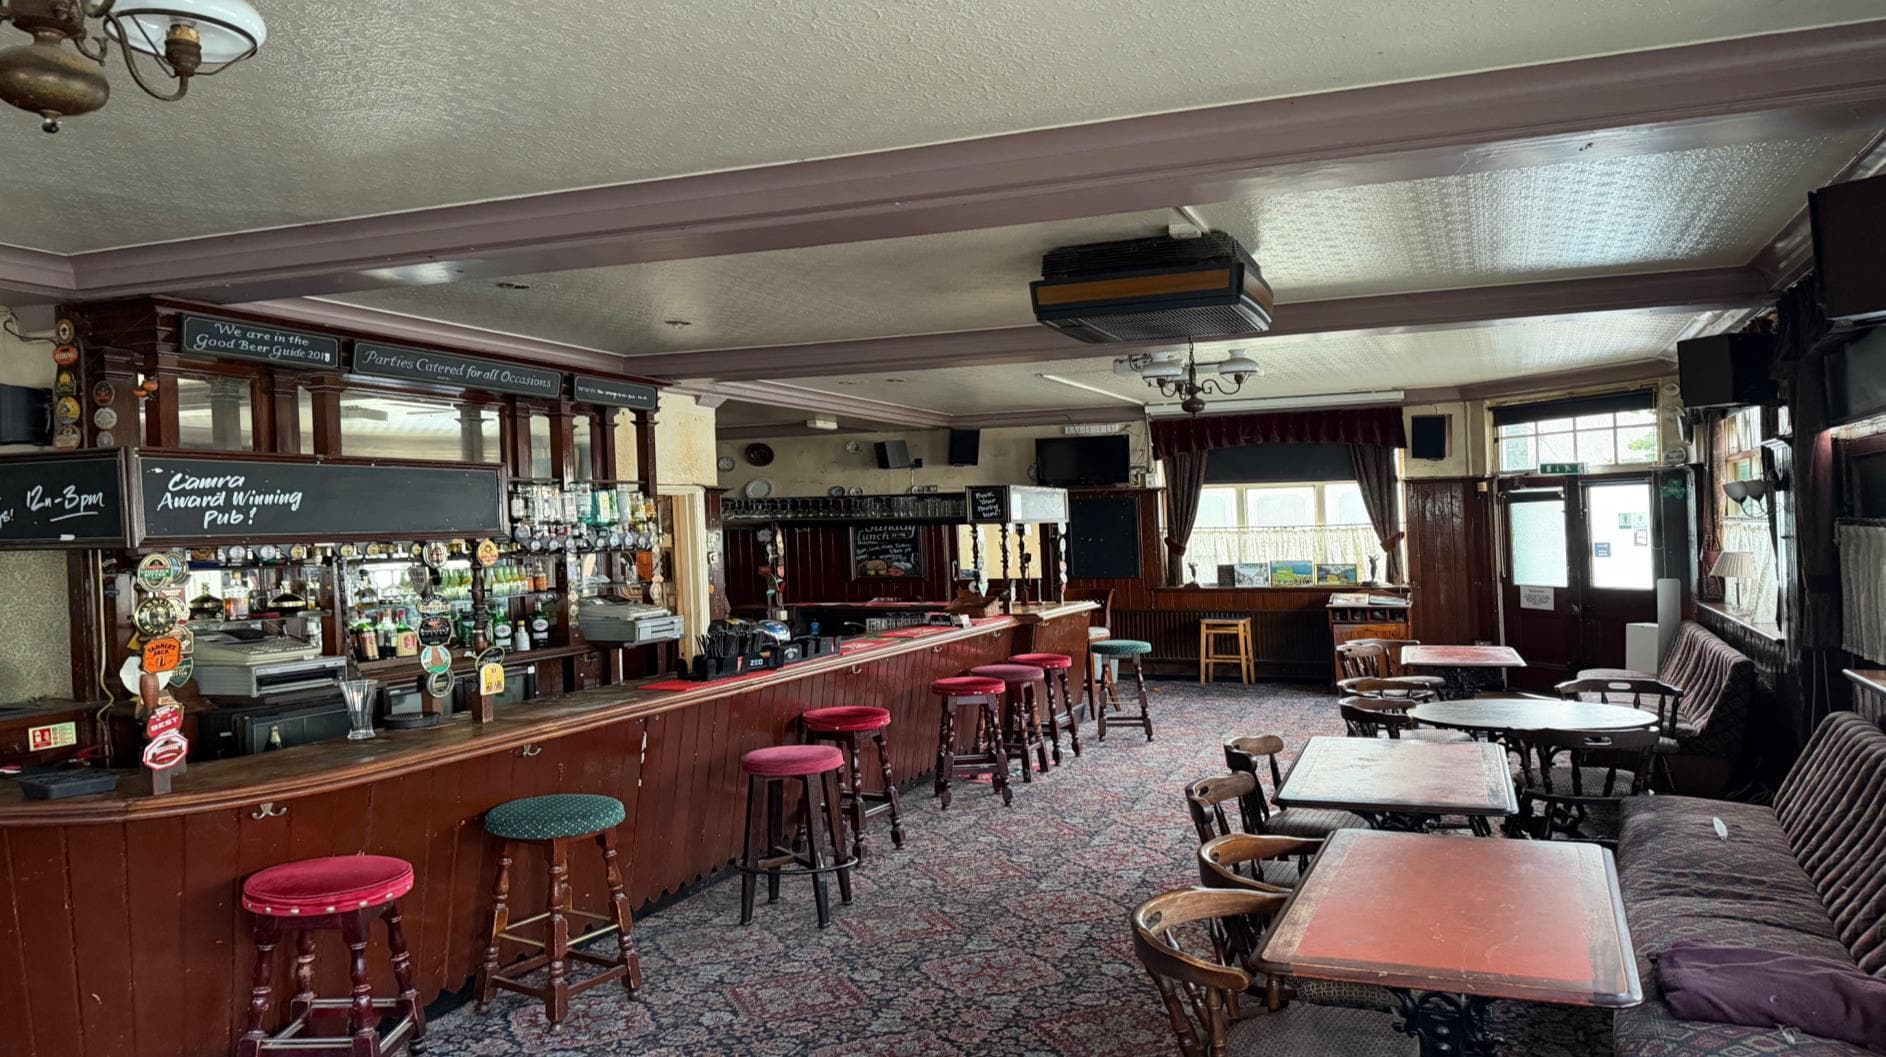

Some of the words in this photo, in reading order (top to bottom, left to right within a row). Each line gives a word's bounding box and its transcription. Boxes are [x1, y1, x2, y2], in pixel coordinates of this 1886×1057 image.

[215, 323, 242, 337] We
[246, 330, 271, 341] are
[274, 332, 286, 343] in
[289, 335, 310, 346] the
[193, 333, 236, 351] Good
[238, 340, 271, 353] Beer
[268, 345, 306, 360] Guide
[361, 350, 414, 369] Parties
[416, 358, 465, 376] Catered
[466, 366, 483, 379] for
[483, 368, 500, 380] all
[501, 371, 551, 388] Occasions
[168, 472, 245, 491] Camra
[157, 491, 226, 511] Award
[232, 489, 303, 511] Winning
